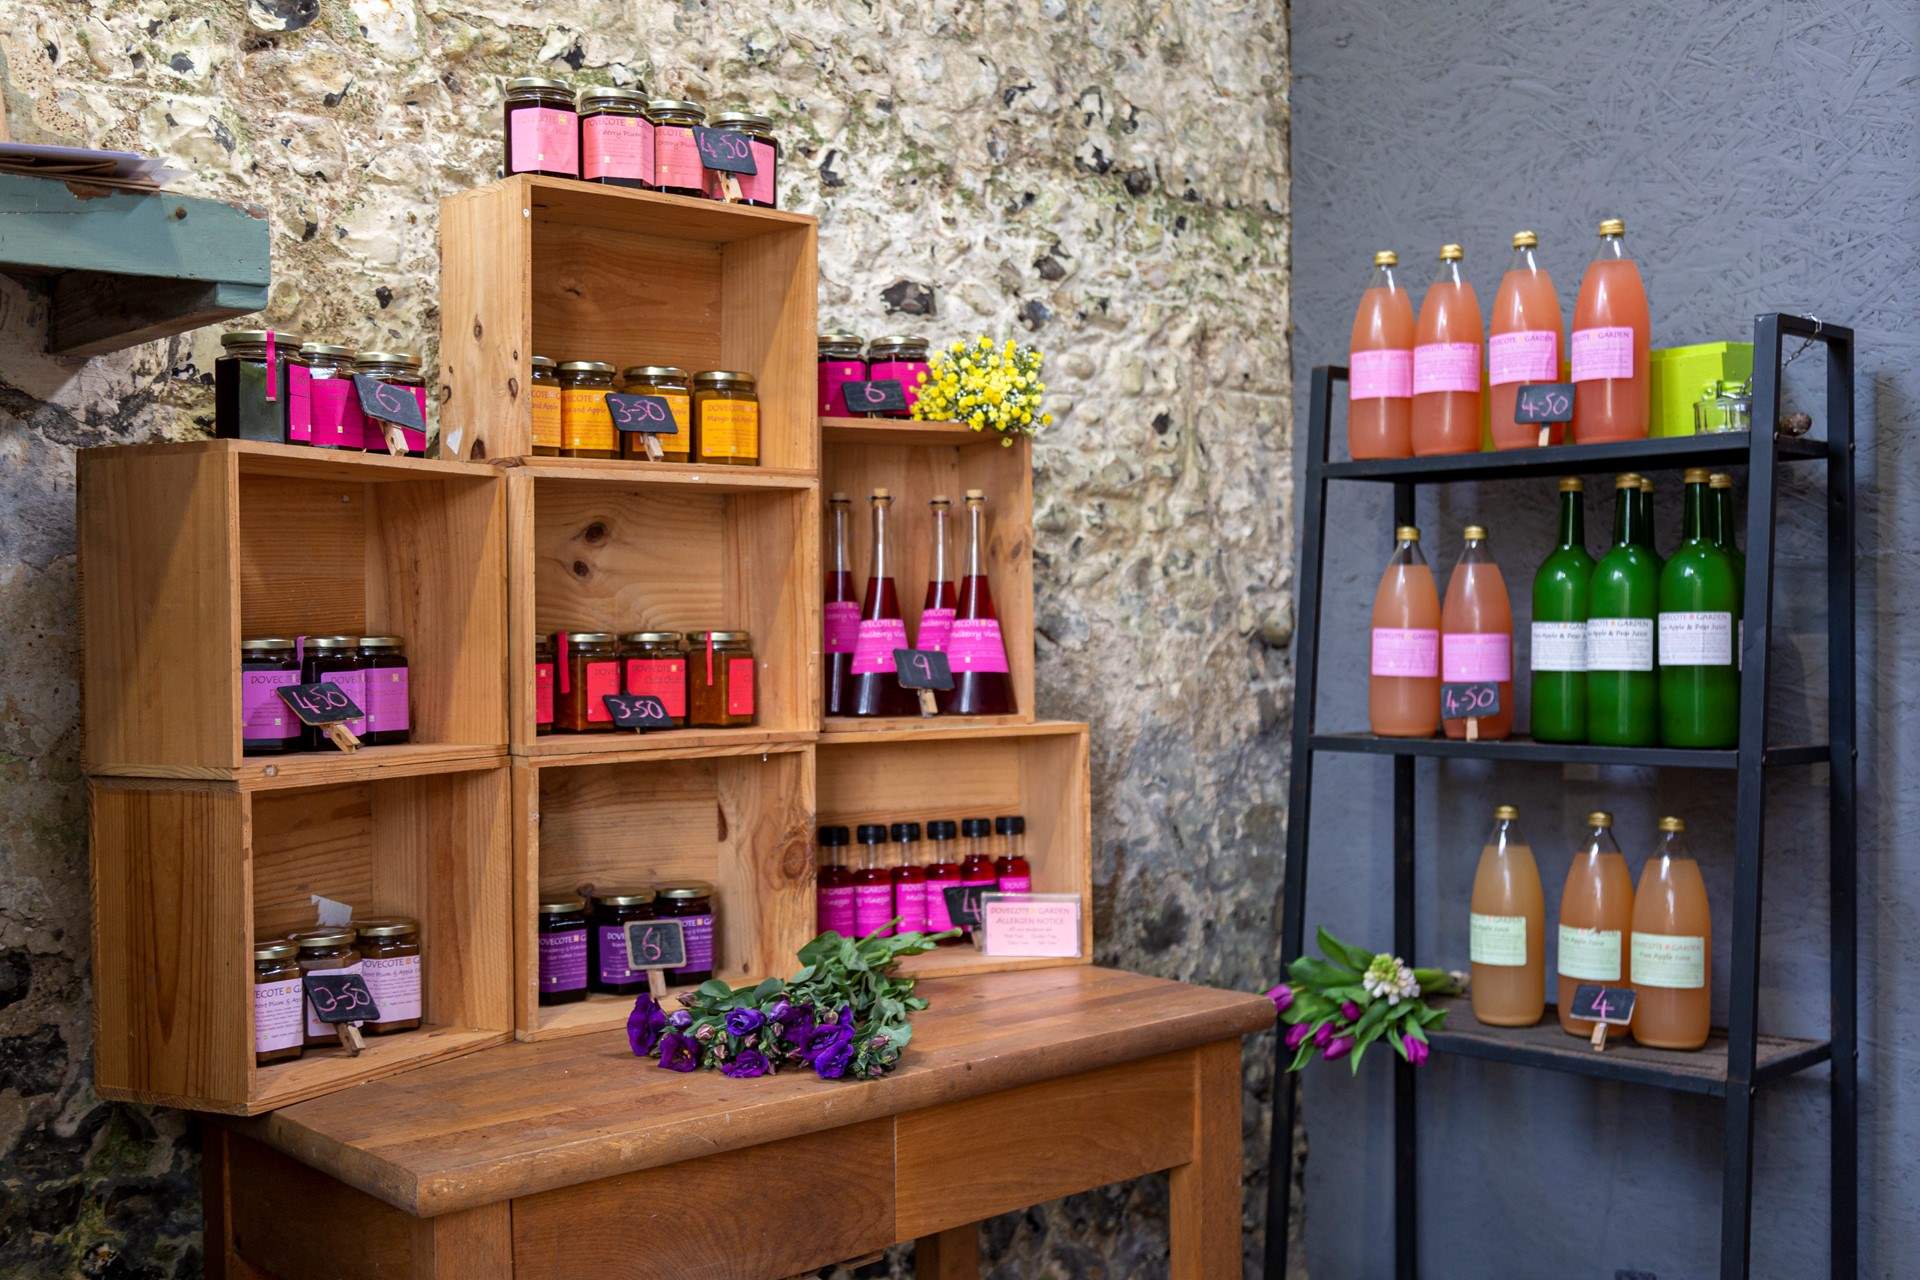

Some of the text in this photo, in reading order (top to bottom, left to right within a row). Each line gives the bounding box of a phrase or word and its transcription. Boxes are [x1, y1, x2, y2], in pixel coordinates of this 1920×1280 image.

[864, 382, 886, 403] 6
[912, 653, 932, 681] 9
[1446, 685, 1495, 715] 4-50
[1036, 917, 1064, 925] NOTICE
[642, 927, 661, 961] 6
[1591, 987, 1615, 1019] 4
